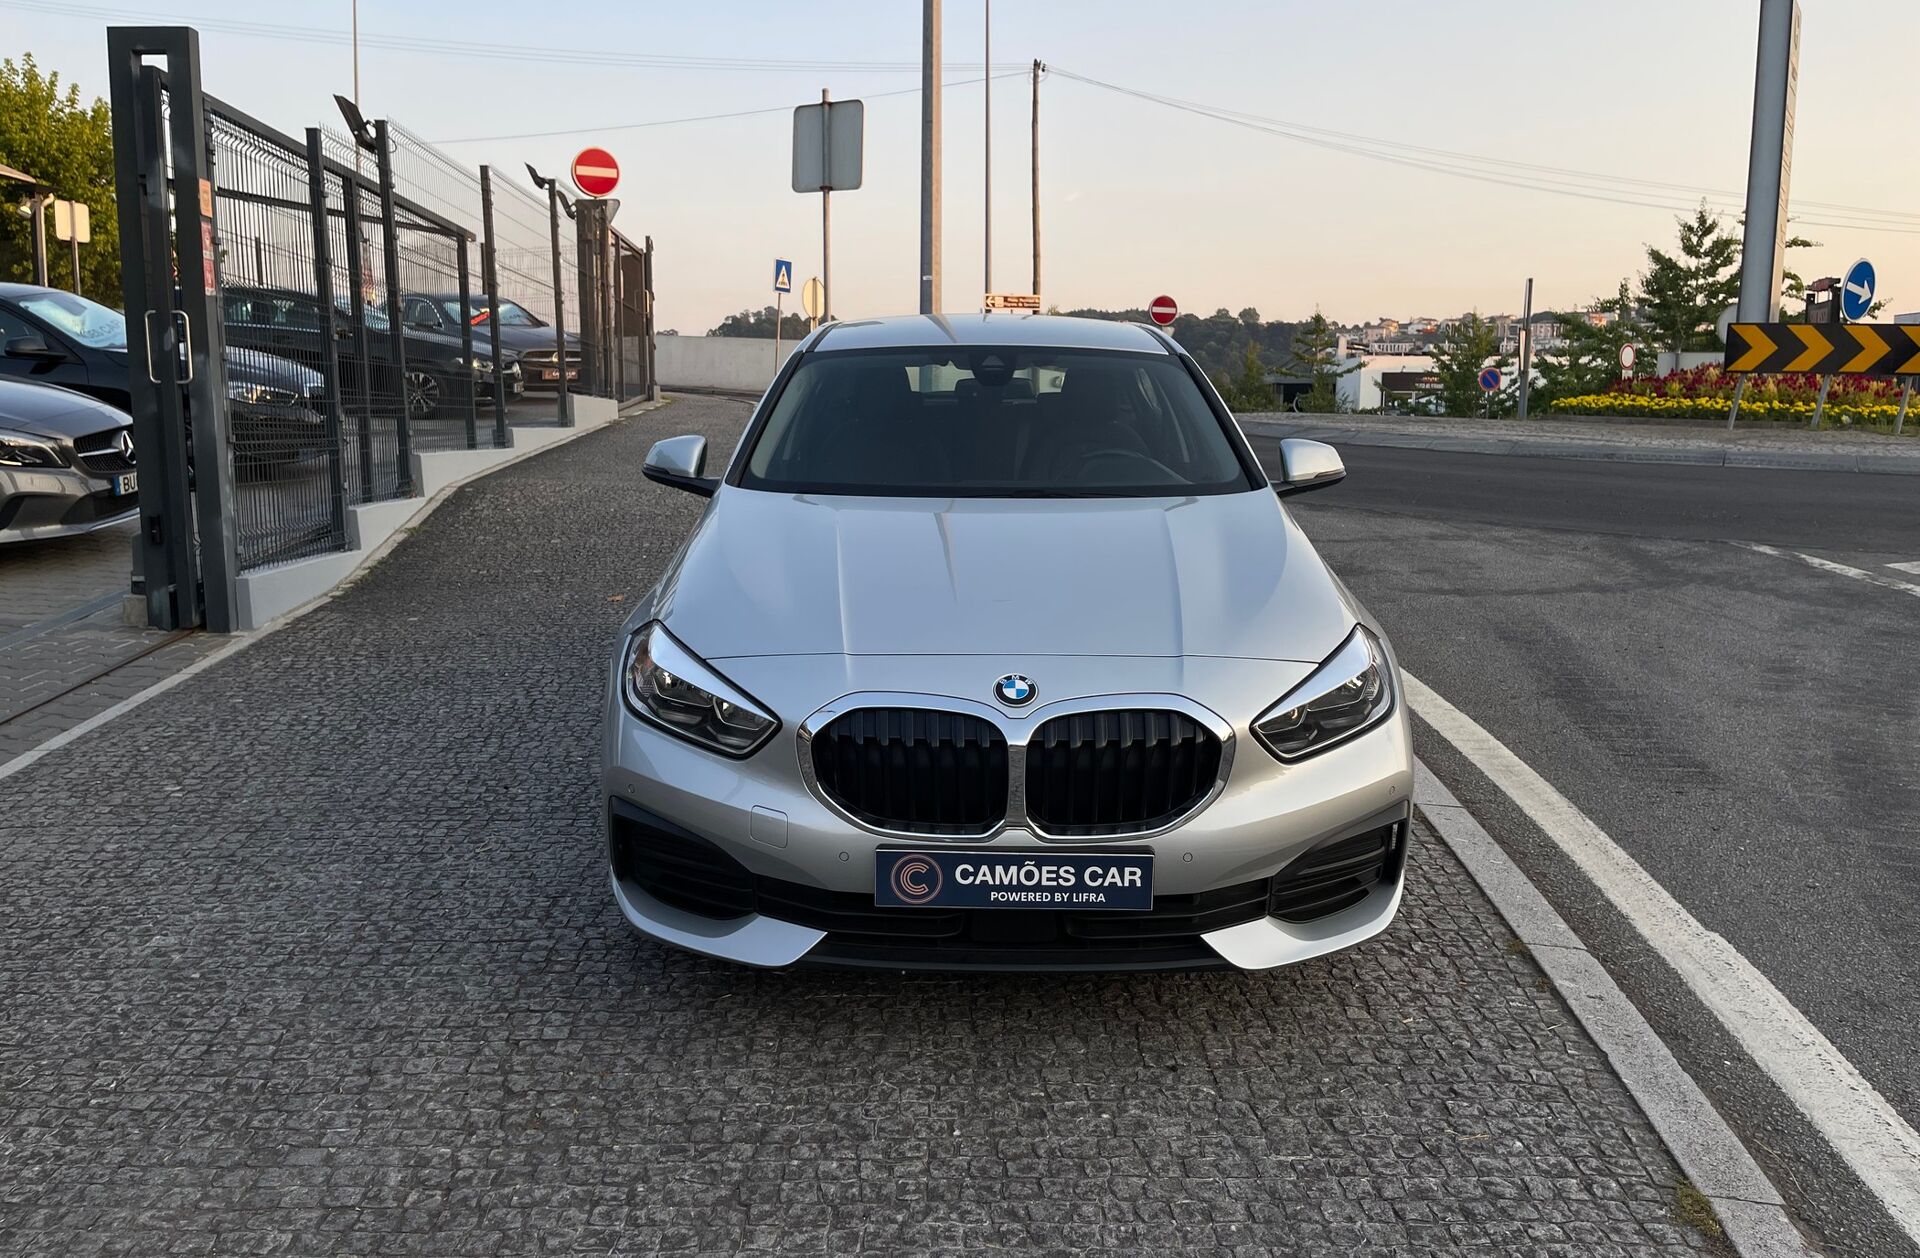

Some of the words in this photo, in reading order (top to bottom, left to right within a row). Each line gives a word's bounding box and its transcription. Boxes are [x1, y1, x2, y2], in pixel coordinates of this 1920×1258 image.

[954, 860, 1076, 887] CAMÕES
[1084, 866, 1142, 888] CAR
[990, 891, 1053, 902] POWERED
[1055, 892, 1070, 902] BY
[1072, 892, 1106, 903] LIFRA
